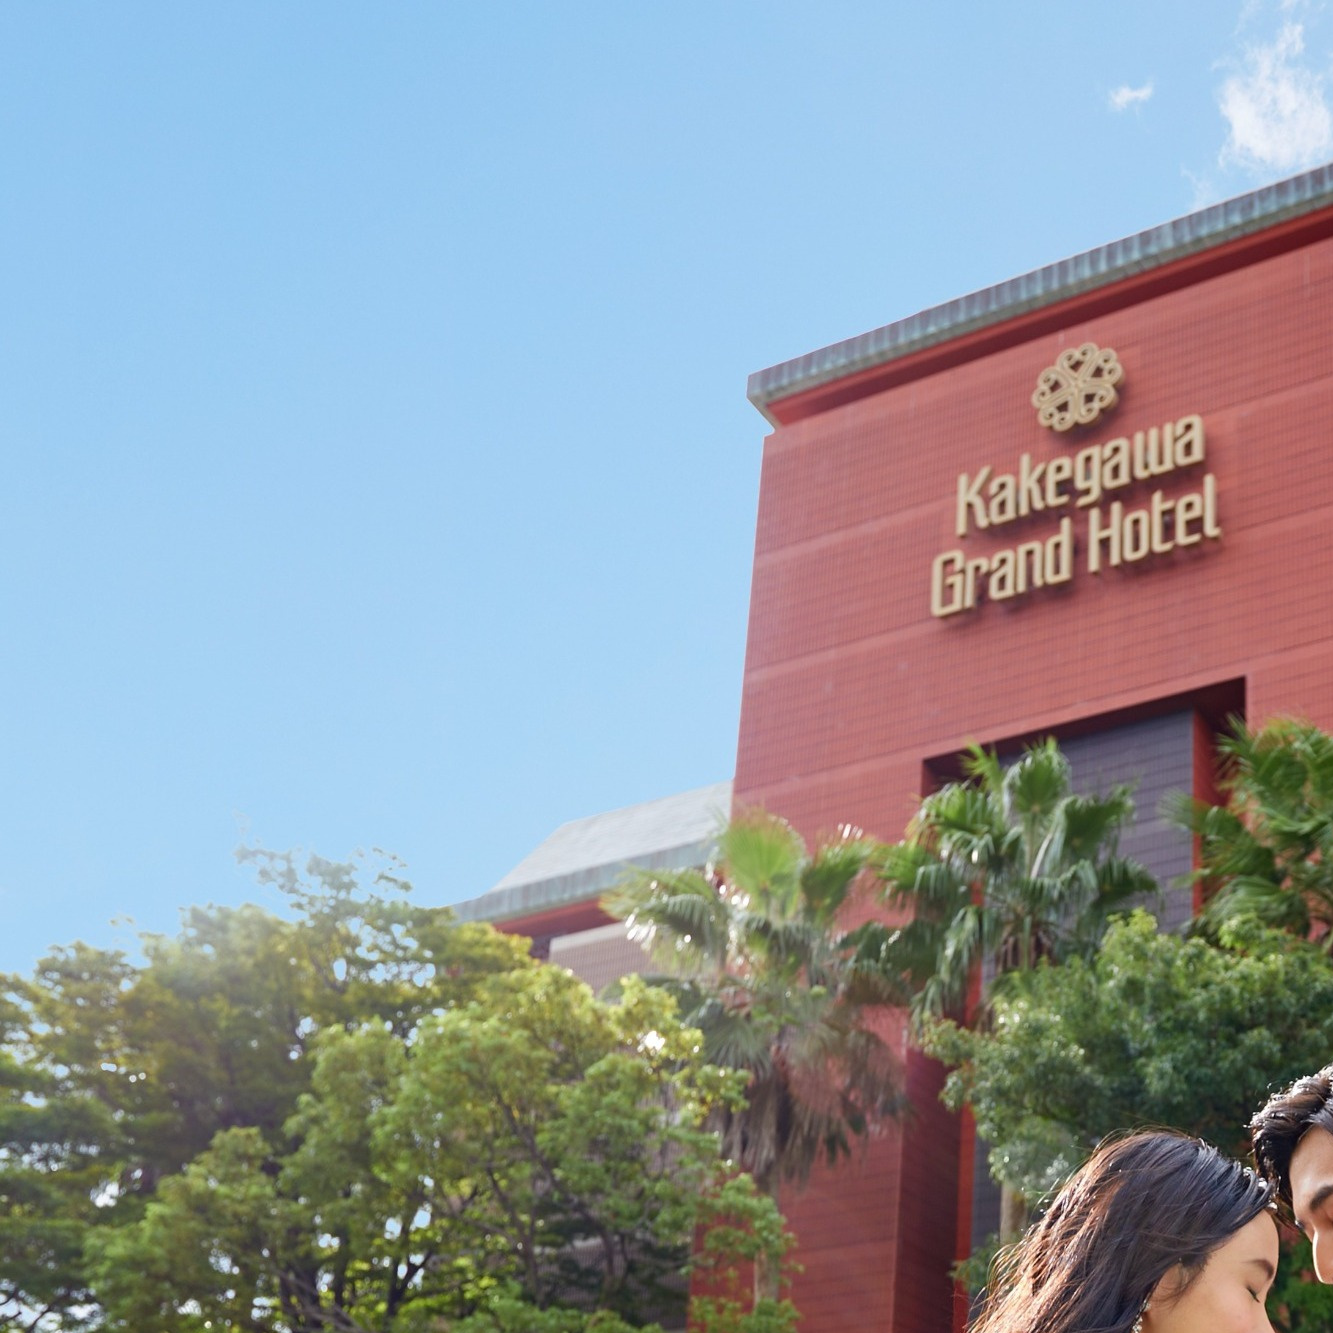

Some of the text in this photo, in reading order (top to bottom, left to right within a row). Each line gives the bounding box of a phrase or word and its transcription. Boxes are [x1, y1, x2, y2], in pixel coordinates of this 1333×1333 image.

[956, 414, 1204, 536] Kakegawa
[931, 473, 1221, 617] Grand Hotel
